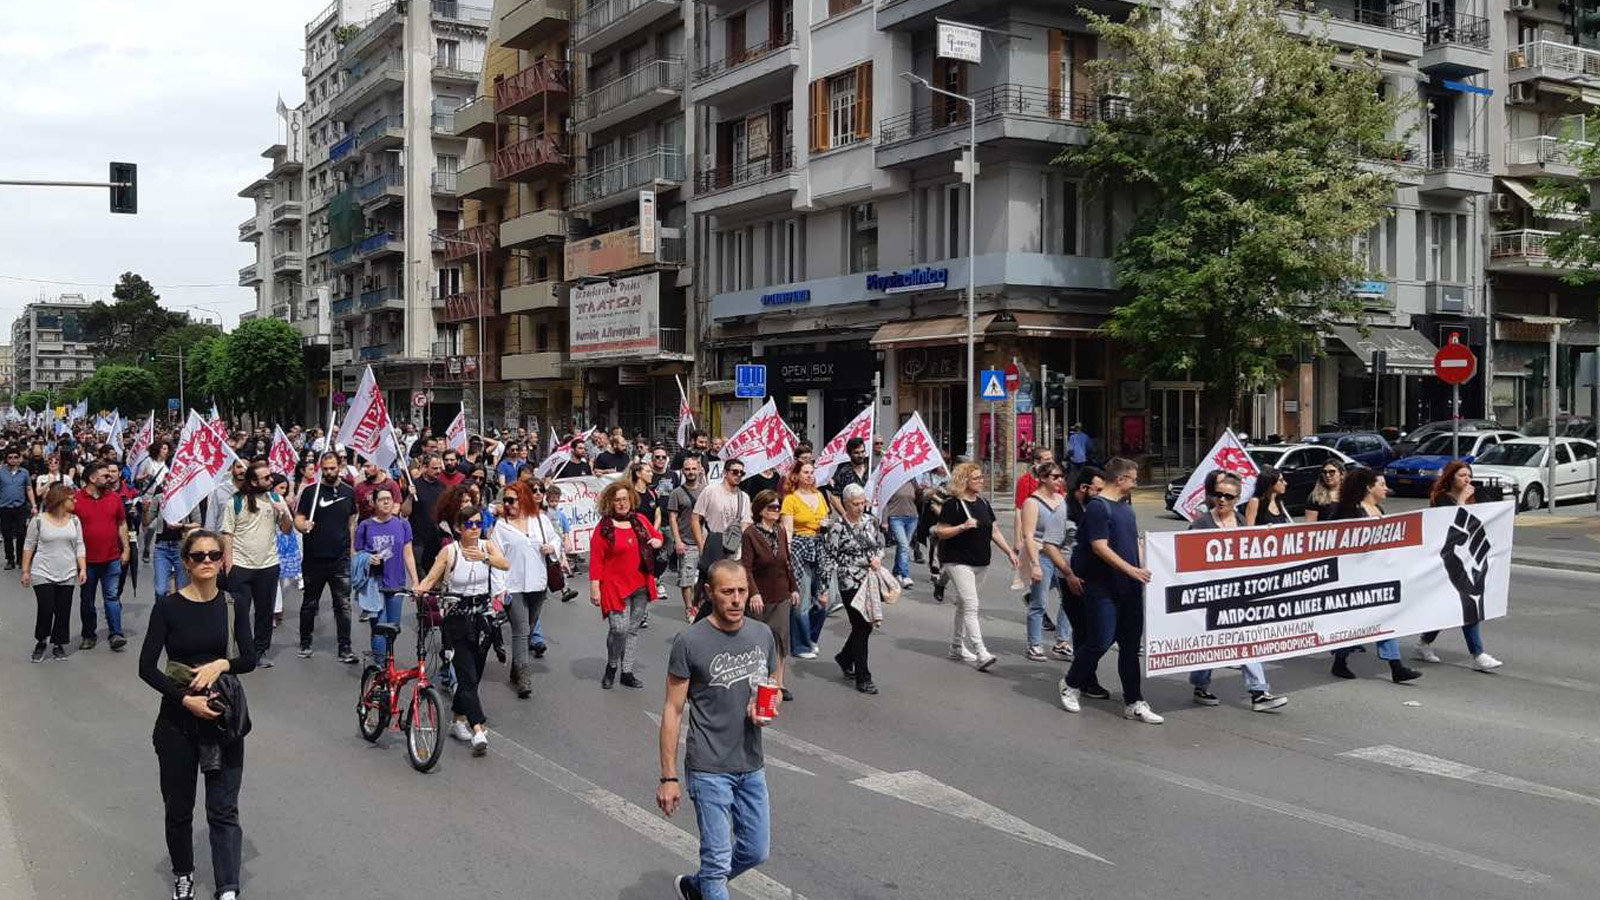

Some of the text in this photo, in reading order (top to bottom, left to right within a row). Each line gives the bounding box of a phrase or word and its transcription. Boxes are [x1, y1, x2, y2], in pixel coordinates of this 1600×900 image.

[575, 295, 642, 315] ΠΛΑΤΩΝ
[781, 363, 834, 376] OPEN BOX
[1206, 521, 1407, 562] ΩΣ ΕΔΩ ΜΕ ΤΗΝ ΑΚΡΙΒΕΙΑ!
[1181, 565, 1329, 605] ΑΥΞΗΣΕΙΣ ΣΤΟΥΣ ΜΙΣΘΟΥΣ
[1217, 587, 1395, 626] ΜΠΡΟΣΤΑ ΟΙ ΔΙΚΕΣ ΜΑΣ ΑΝΑΓΚΕΣ
[1149, 635, 1214, 655] ΣΥΝΔΙΚΑΤΟ
[1241, 648, 1249, 658] &
[1252, 636, 1317, 656] ΠΛΗΡΟΦΟΡΙΚΗΣ
